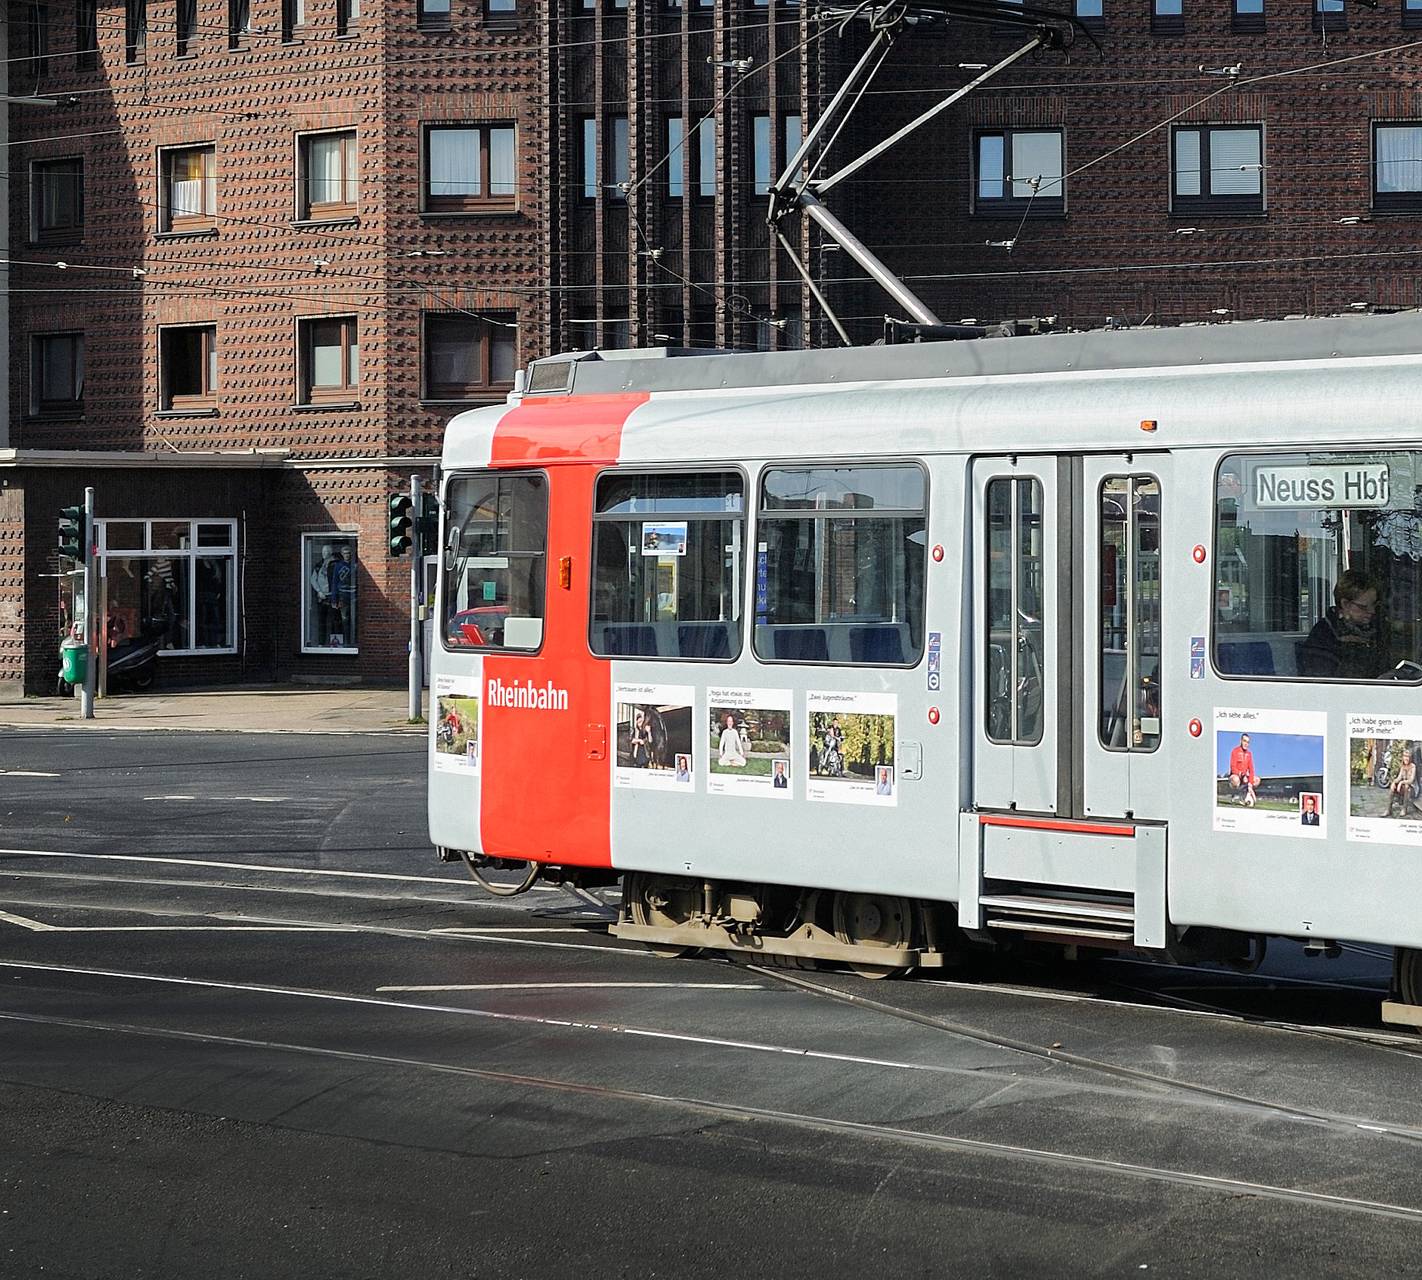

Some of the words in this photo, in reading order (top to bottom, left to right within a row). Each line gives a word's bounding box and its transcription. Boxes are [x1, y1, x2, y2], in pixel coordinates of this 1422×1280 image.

[1259, 473, 1335, 501] Neuss
[1344, 470, 1388, 500] Hbf
[488, 677, 568, 710] Rheinbahn
